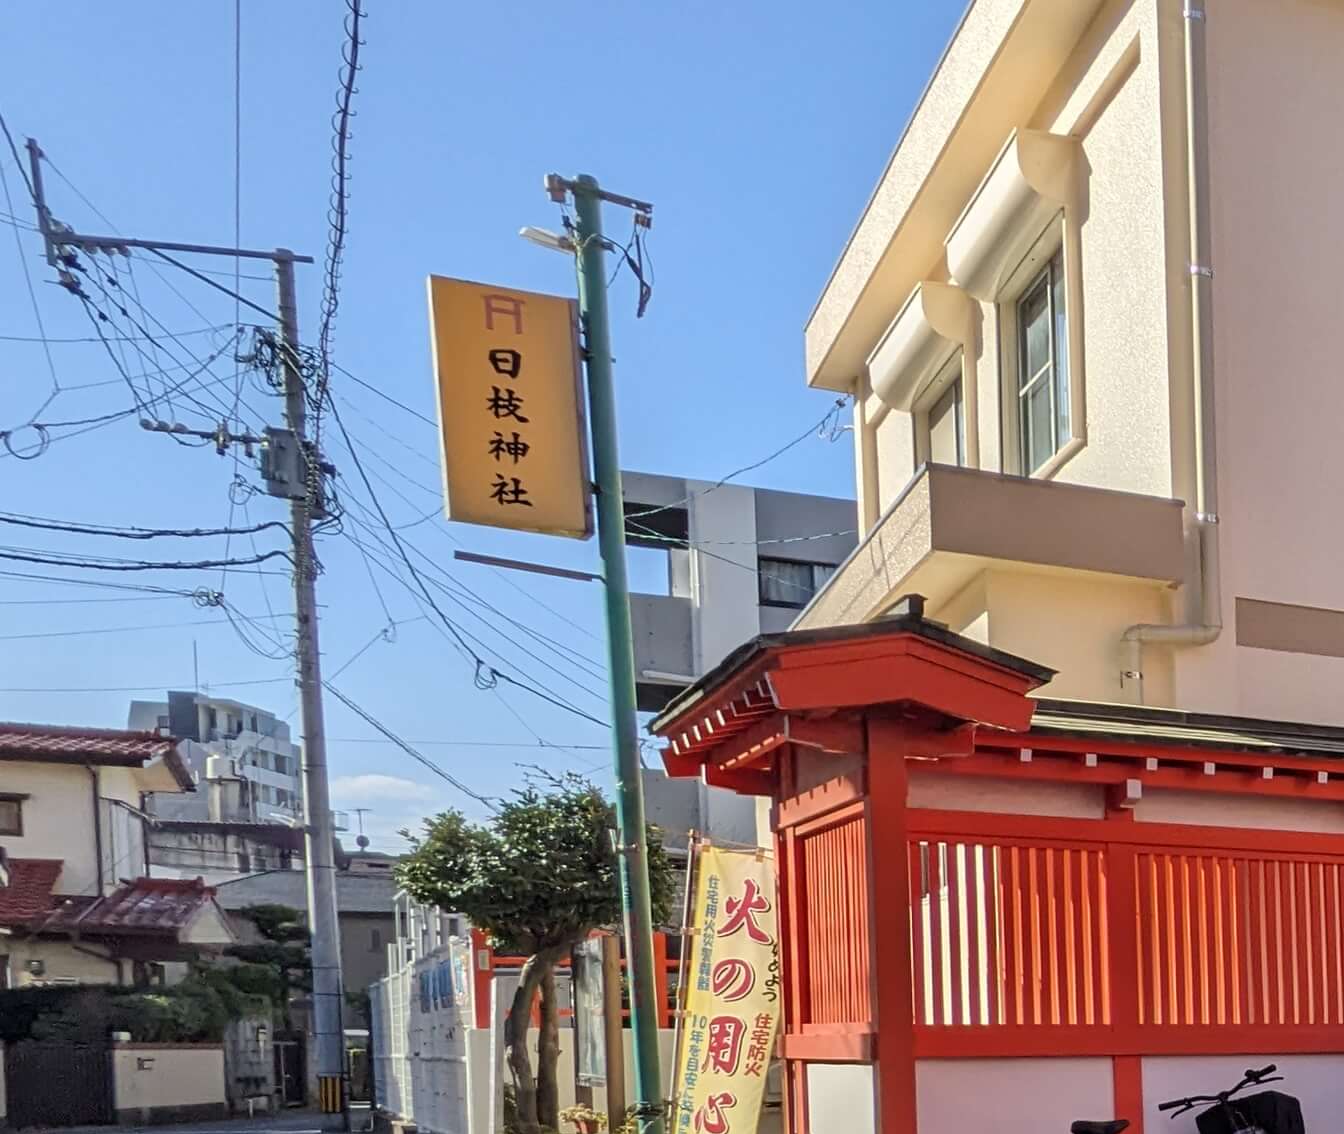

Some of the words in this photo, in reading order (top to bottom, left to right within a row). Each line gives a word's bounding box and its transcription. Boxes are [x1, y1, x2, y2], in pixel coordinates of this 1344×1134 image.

[486, 348, 533, 508] 日枝神社
[743, 1012, 774, 1078] 住宅防火
